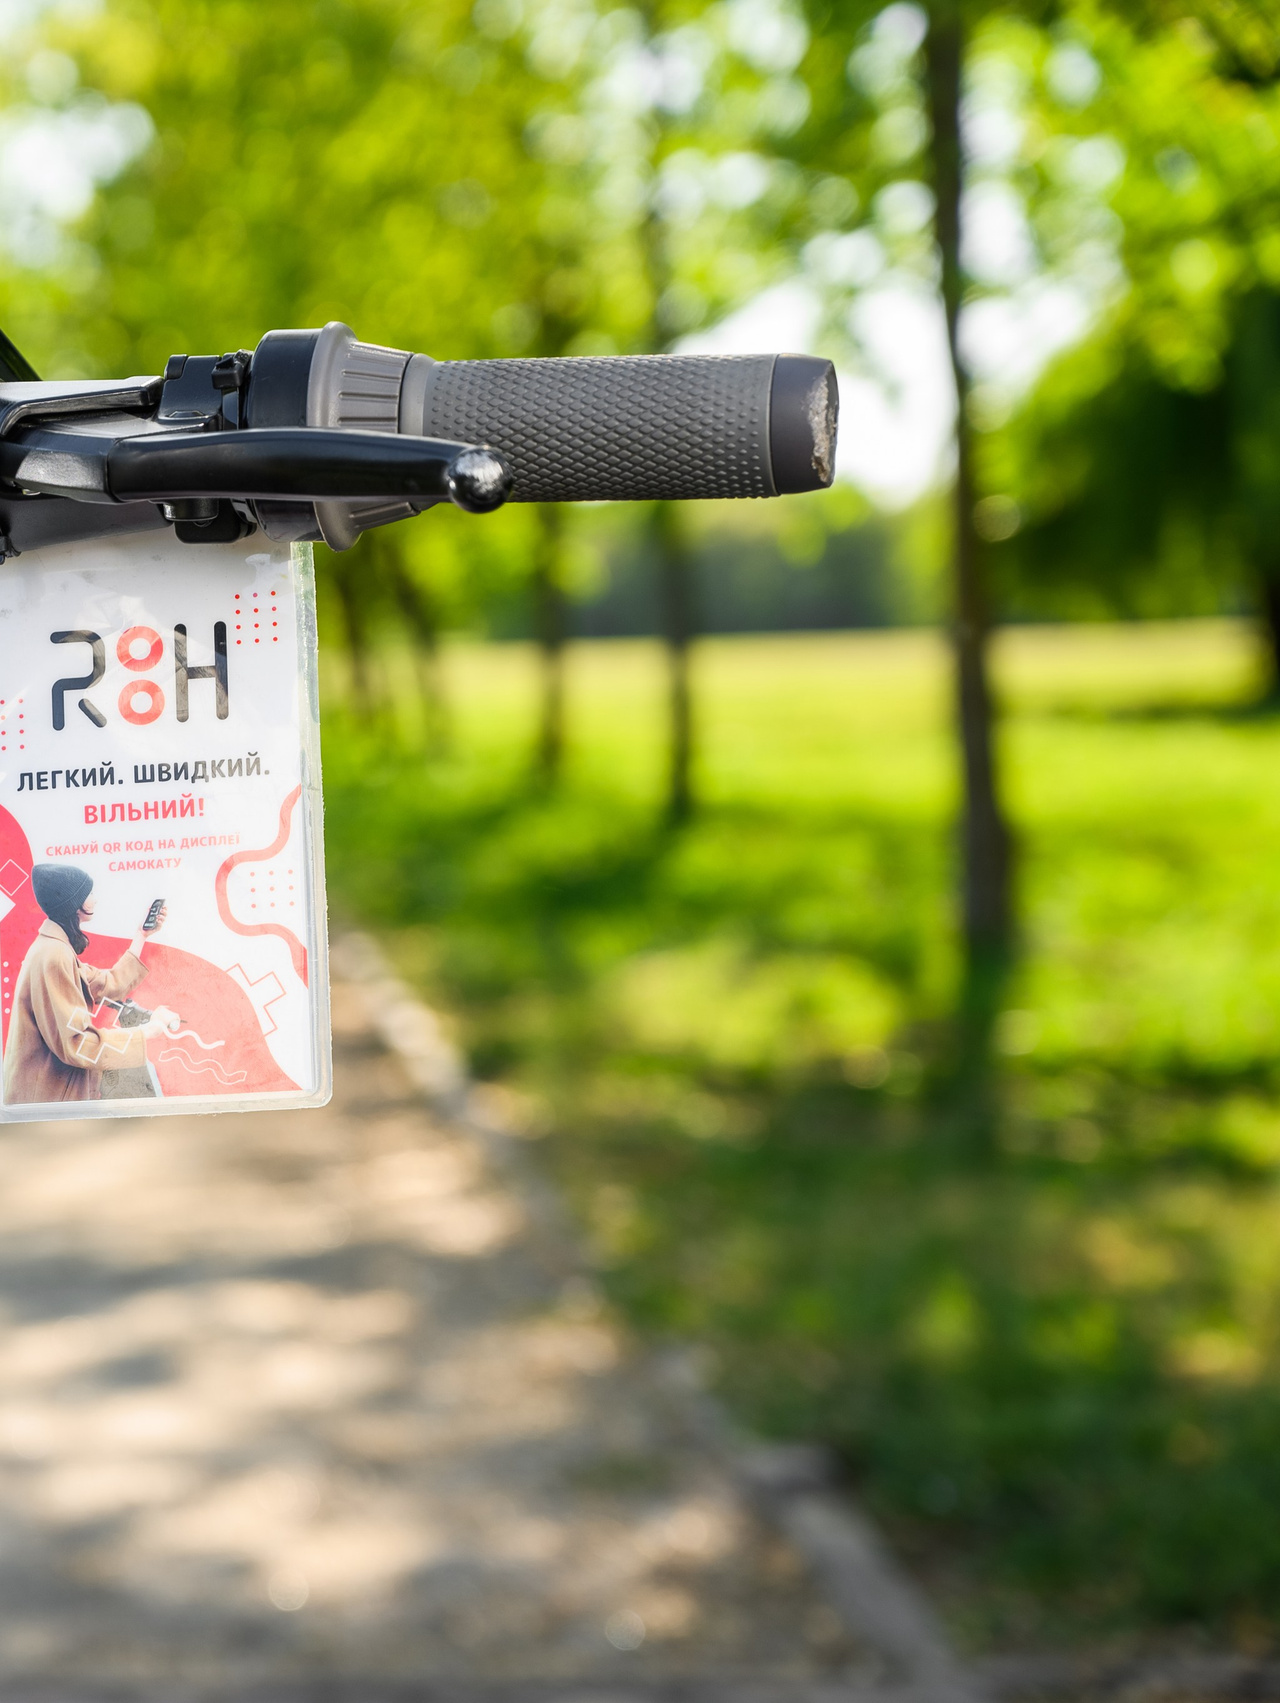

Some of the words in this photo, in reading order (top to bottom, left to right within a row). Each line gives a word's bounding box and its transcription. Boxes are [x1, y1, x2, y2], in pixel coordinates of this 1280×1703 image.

[17, 761, 124, 792] ЛЕГКИЙ.
[133, 752, 270, 784] ШВИДКИЙ.
[83, 793, 205, 825] ВІЛЬНИЙ!
[45, 840, 99, 857] СКАНУЙ
[103, 842, 121, 854] QR
[125, 840, 154, 853] КОД
[158, 838, 176, 850] НА
[108, 857, 182, 872] САМОКАТУ
